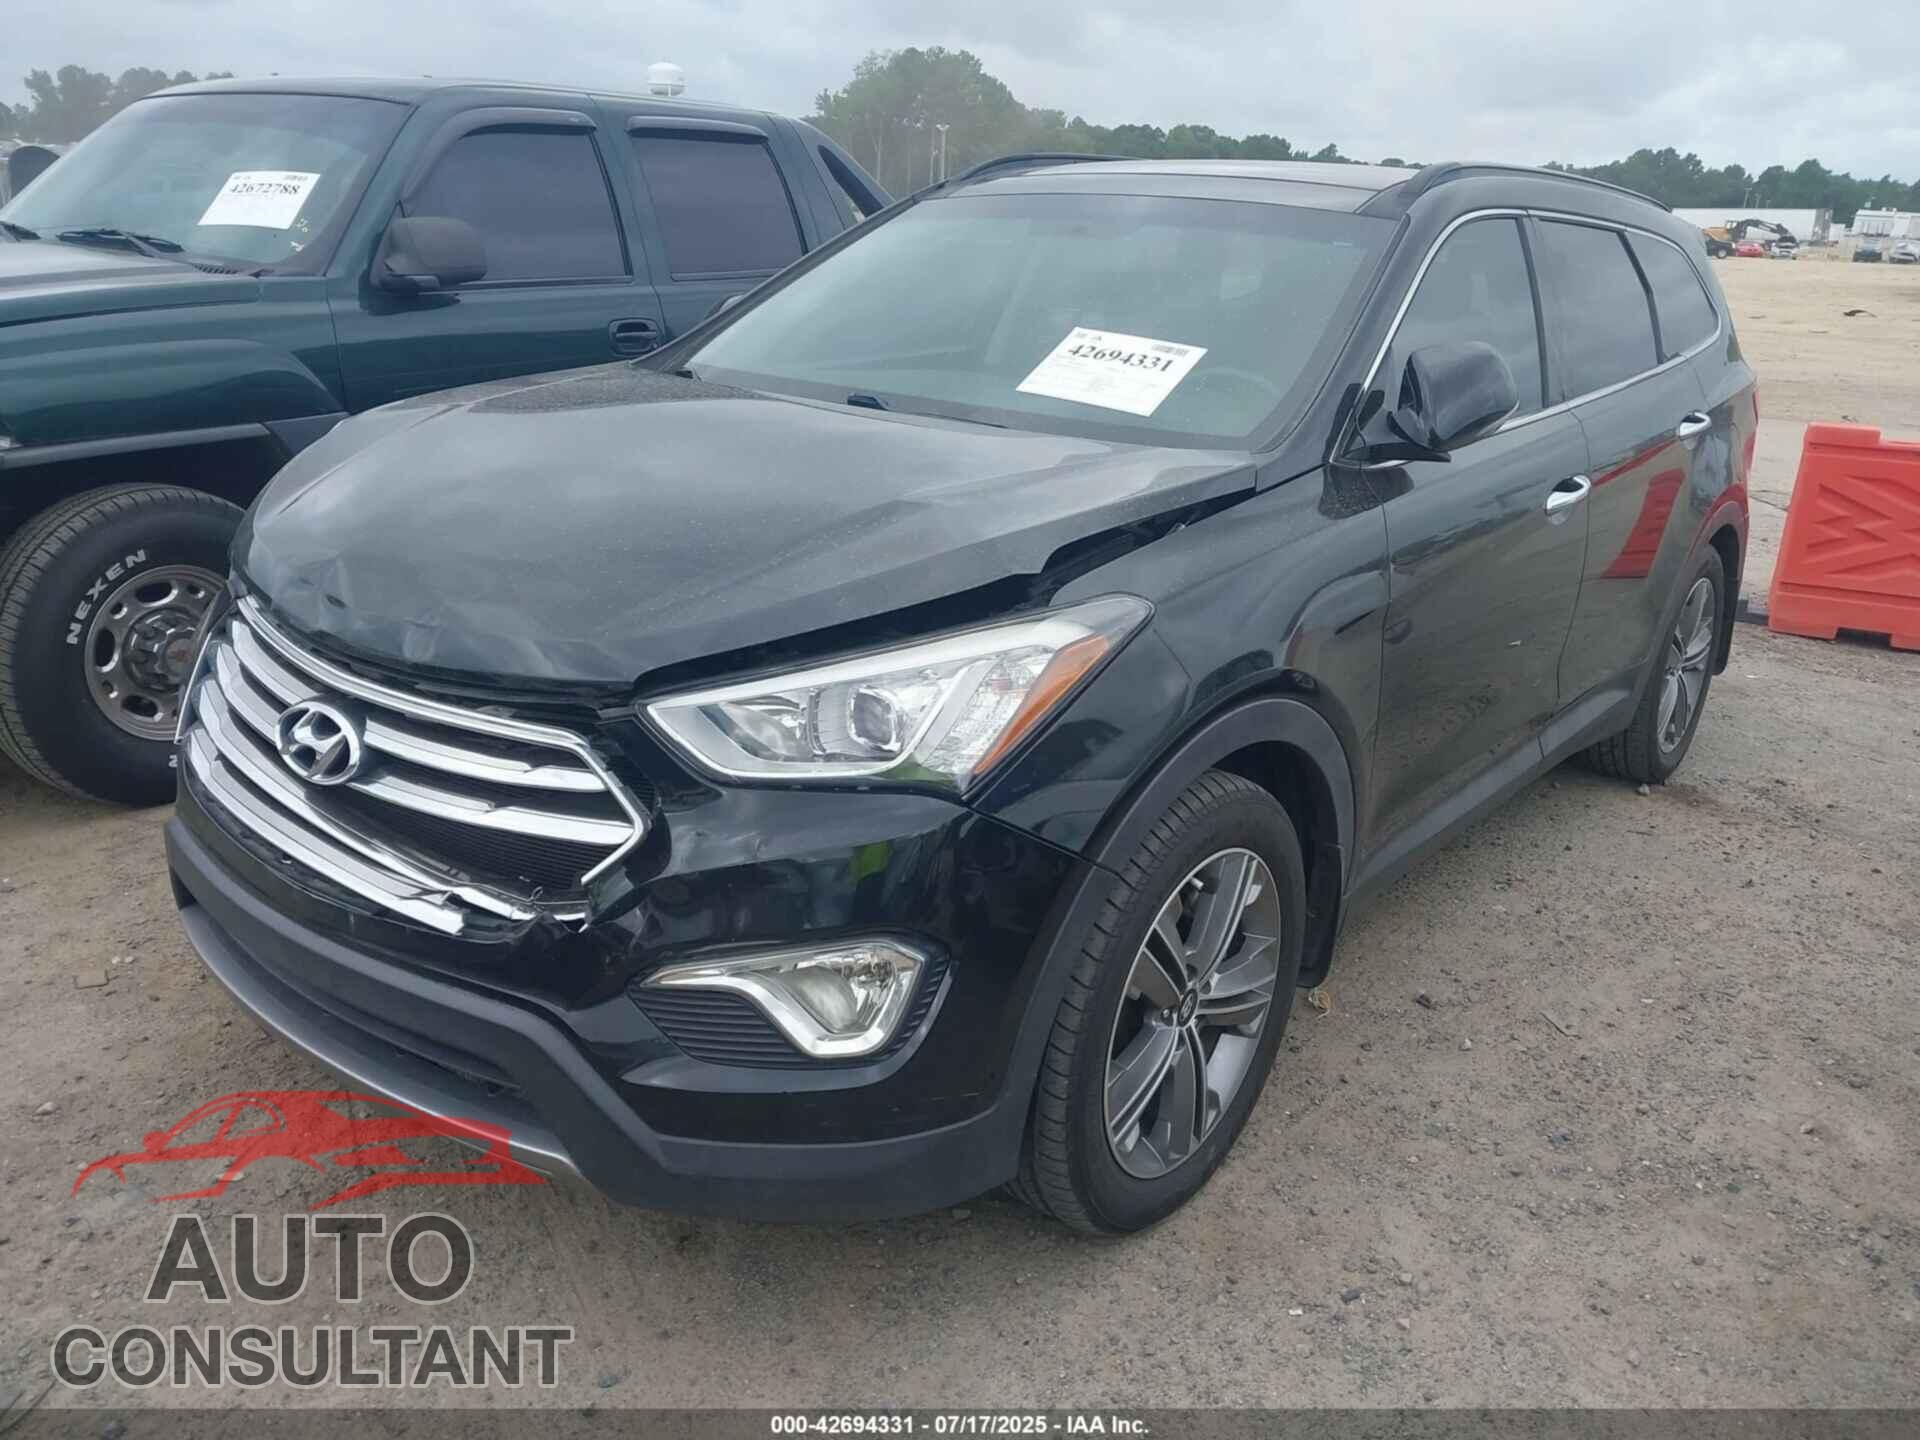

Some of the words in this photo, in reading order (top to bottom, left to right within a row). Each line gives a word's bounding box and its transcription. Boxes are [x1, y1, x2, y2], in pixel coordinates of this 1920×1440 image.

[230, 183, 300, 195] 42672788
[1067, 344, 1174, 372] 42694331
[66, 549, 146, 645] NEXEN
